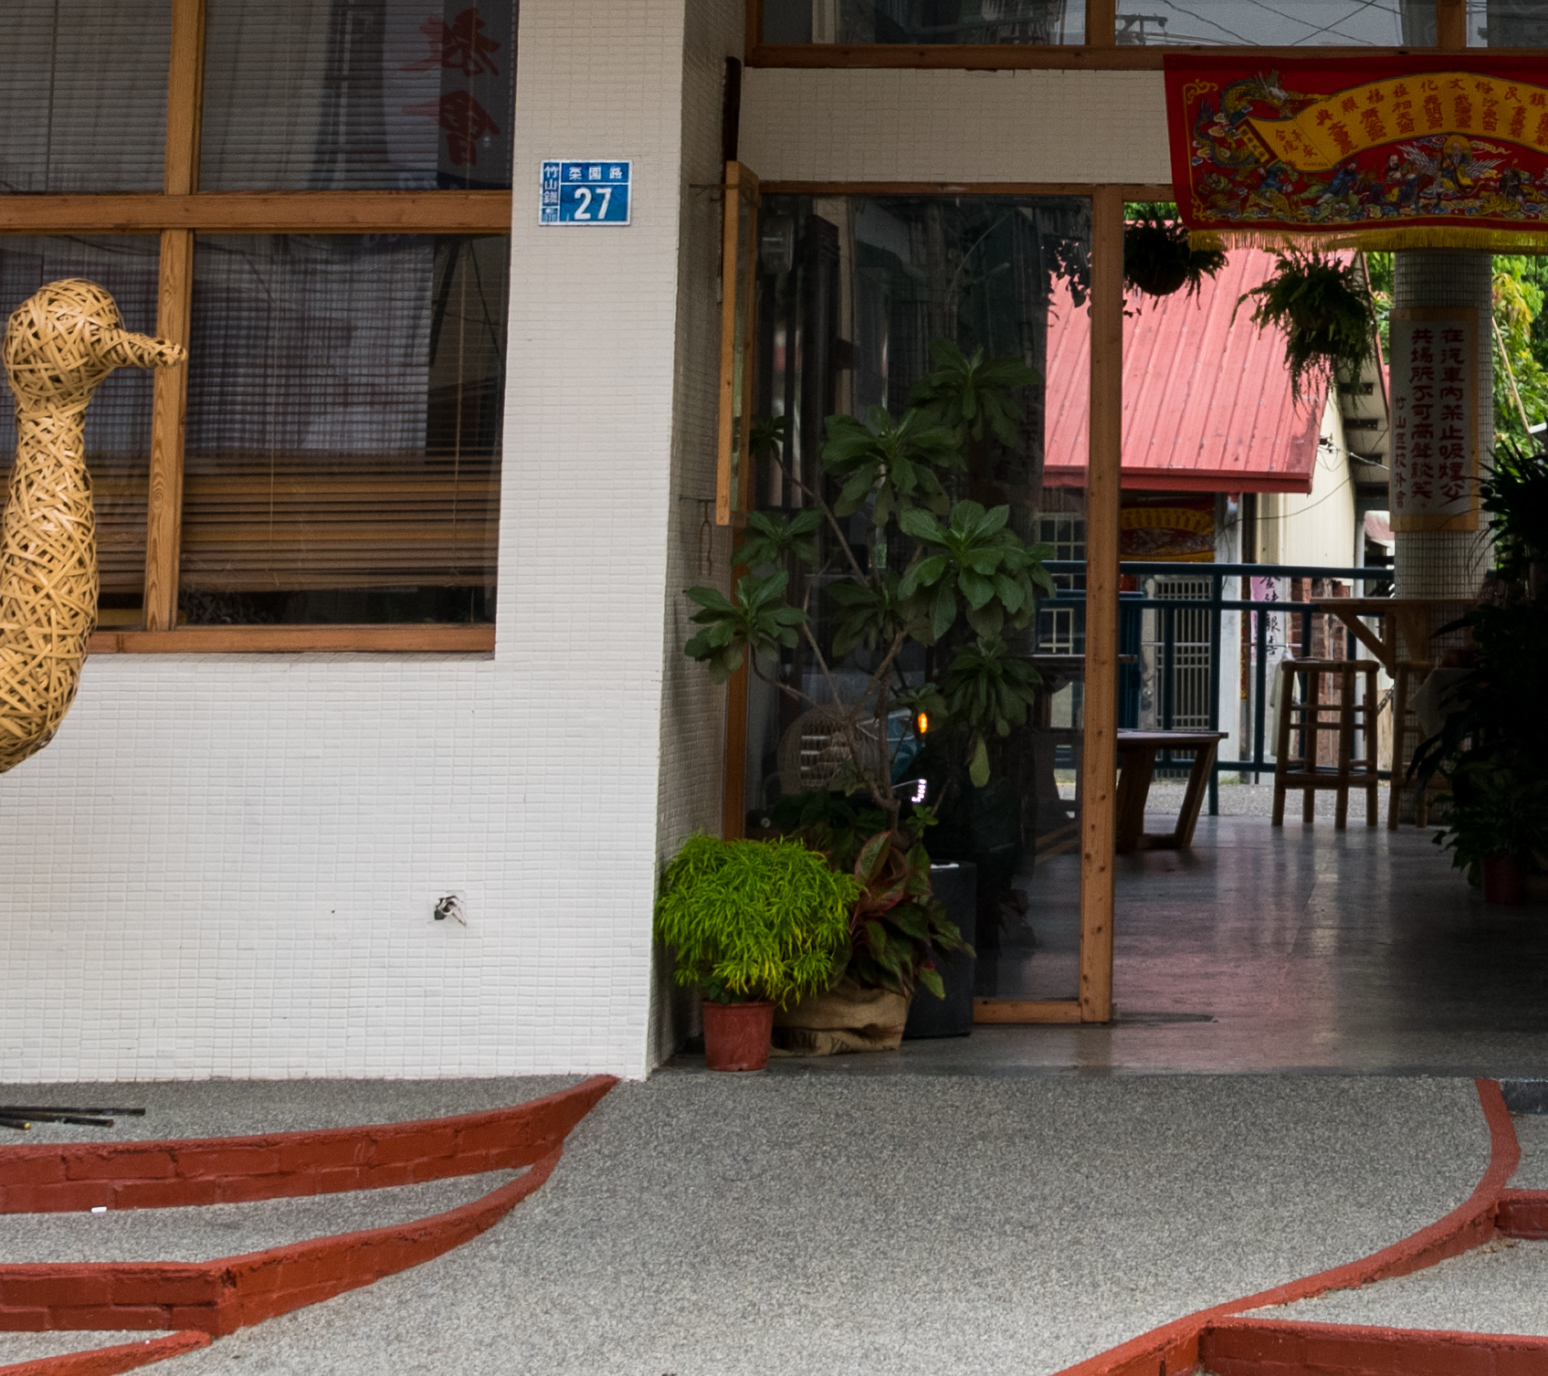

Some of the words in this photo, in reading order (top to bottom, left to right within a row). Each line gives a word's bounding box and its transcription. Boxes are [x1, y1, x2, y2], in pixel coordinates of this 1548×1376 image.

[543, 165, 559, 204] 竹山鎮
[574, 186, 612, 220] 27
